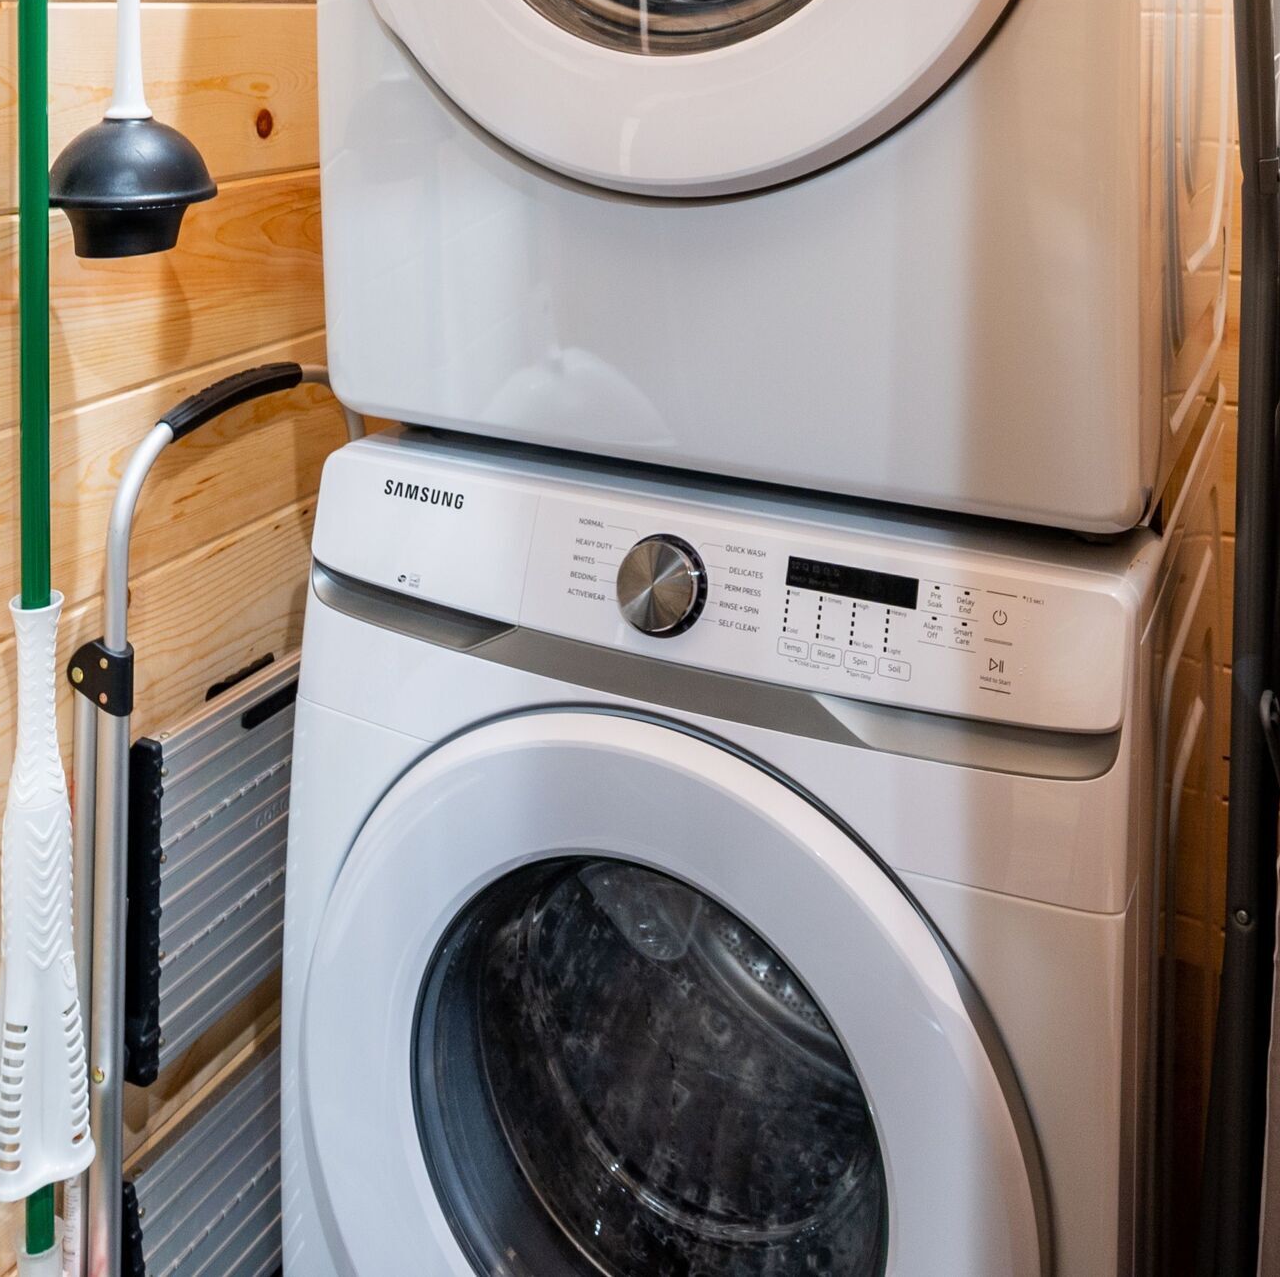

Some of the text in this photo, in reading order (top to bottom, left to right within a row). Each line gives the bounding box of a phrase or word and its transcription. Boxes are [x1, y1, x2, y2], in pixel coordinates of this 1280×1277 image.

[383, 479, 465, 511] SAMSUNG
[579, 517, 605, 529] NORMAL
[575, 537, 613, 551] HEAVY DUTY
[725, 544, 767, 559] QUICK WASH
[573, 554, 596, 565] WHITES
[570, 570, 598, 583] BEDDING
[728, 566, 764, 580] DELICATES
[567, 588, 606, 602] ACTIVEWEAR
[724, 583, 762, 598] PERM PRESS
[930, 591, 942, 601] Pre
[719, 600, 738, 612] RINSE
[744, 604, 760, 615] SPIN
[927, 599, 943, 609] Soak
[956, 596, 976, 607] Delay
[958, 605, 972, 615] End
[718, 618, 734, 628] SELF
[923, 621, 944, 632] Alarm
[926, 630, 939, 640] Off
[953, 627, 974, 638] Smart
[955, 636, 971, 646] Care
[783, 642, 803, 654] Temp.
[817, 649, 837, 661] Rinse
[852, 657, 868, 667] Spin
[887, 663, 902, 675] Soil
